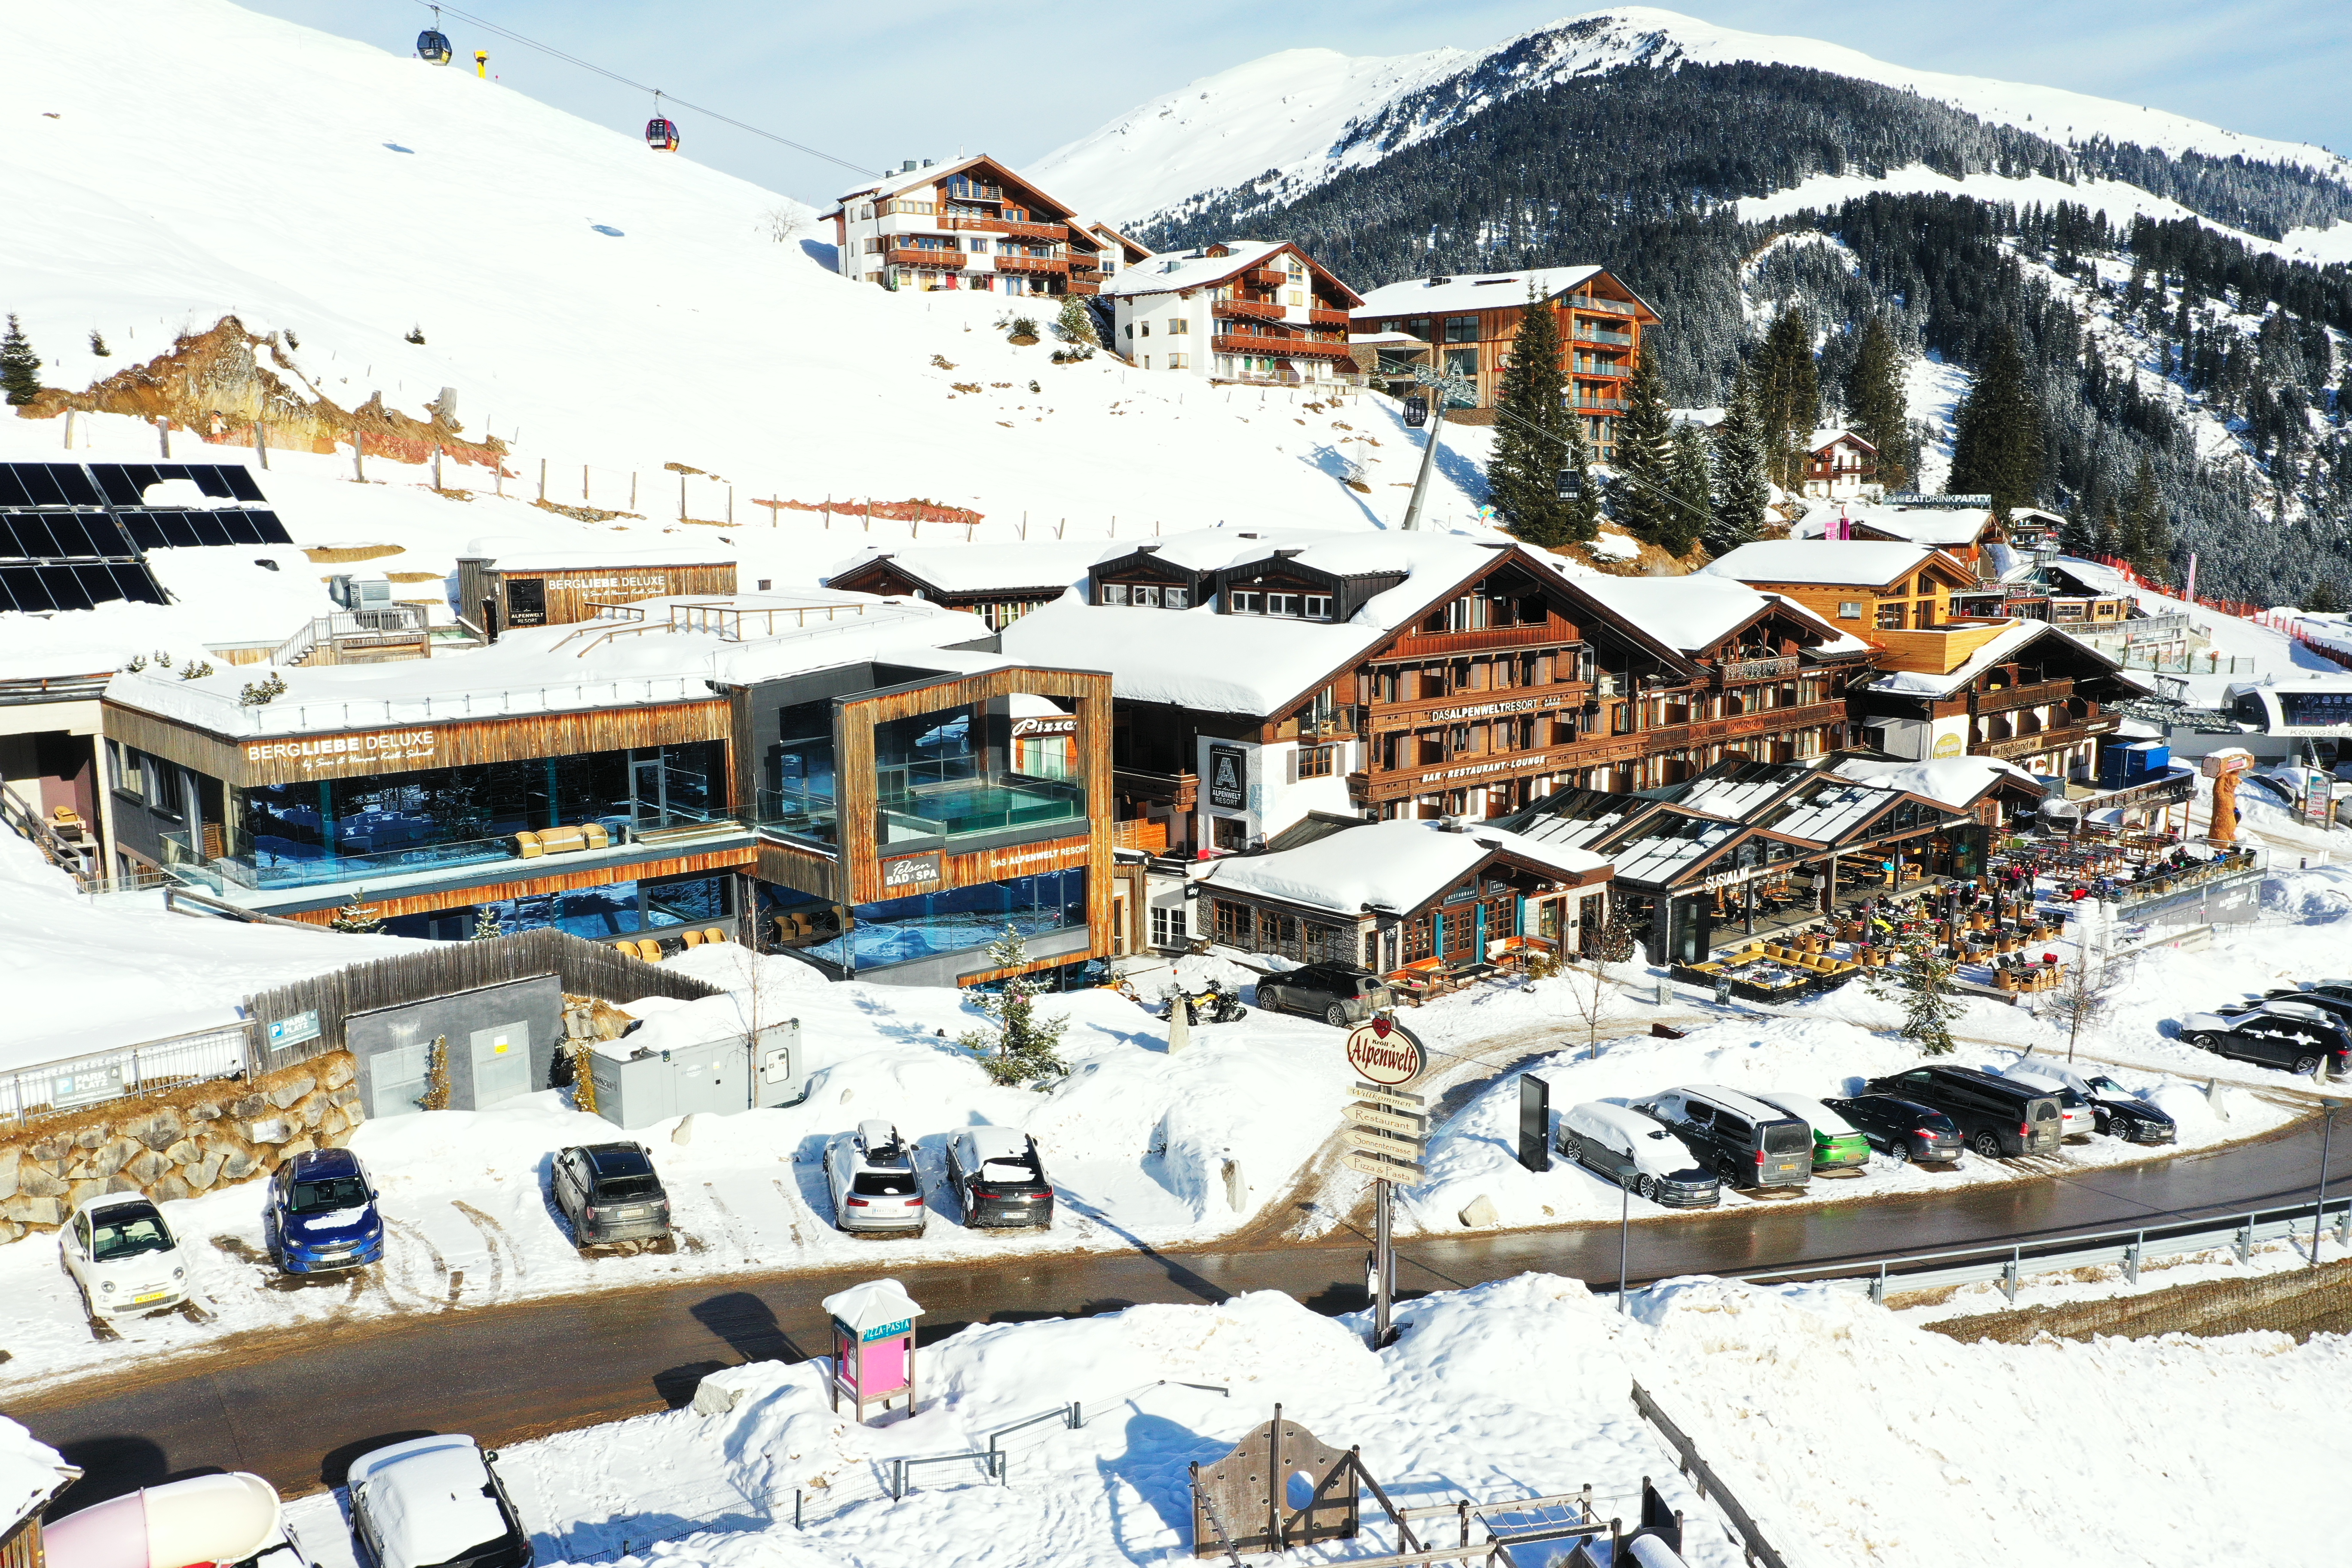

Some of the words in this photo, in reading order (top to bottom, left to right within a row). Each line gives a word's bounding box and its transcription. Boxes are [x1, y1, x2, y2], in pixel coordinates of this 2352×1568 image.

[548, 578, 618, 590] BERGLIEBE
[622, 576, 665, 587] DELUXE
[582, 590, 588, 600] by
[1012, 718, 1077, 736] Pizze
[248, 738, 360, 761] BERGLIEBE
[366, 731, 434, 750] DELUXE
[2000, 740, 2029, 757] Highland
[303, 758, 313, 772] by
[315, 757, 334, 767] Susi
[337, 756, 345, 765] &
[348, 755, 377, 764] Hannes
[1422, 772, 1441, 782] BAR
[1448, 762, 1506, 778] RESTAURANT
[1511, 755, 1546, 767] LOUNGE
[1212, 789, 1241, 800] ALPENWELT
[1215, 796, 1237, 805] RESORT
[991, 858, 1007, 868] DAS
[1009, 849, 1059, 865] ALPENWELT
[1060, 844, 1090, 856] RESORT
[886, 873, 909, 885] BAD
[916, 869, 937, 881] SPA
[893, 860, 931, 877] Felsen
[1705, 867, 1749, 891] SUSIALM
[1188, 887, 1199, 895] sky
[1448, 889, 1475, 900] RESTAURANT
[2219, 893, 2247, 908] ALPENWELT
[283, 1014, 307, 1029] PARK
[284, 1022, 309, 1035] PLATZ
[1349, 1035, 1417, 1074] Alpenwelt
[75, 1070, 107, 1084] PARK
[75, 1078, 108, 1091] PLATZ
[591, 1073, 618, 1092] essari
[1351, 1088, 1412, 1108] Willkommen
[1355, 1109, 1410, 1130] Restaurant
[1354, 1134, 1412, 1156] Sonnenterrasse
[1354, 1158, 1375, 1172] Pizza
[1386, 1166, 1410, 1181] Pasta
[862, 1319, 910, 1339] PIZZA-PASTA
